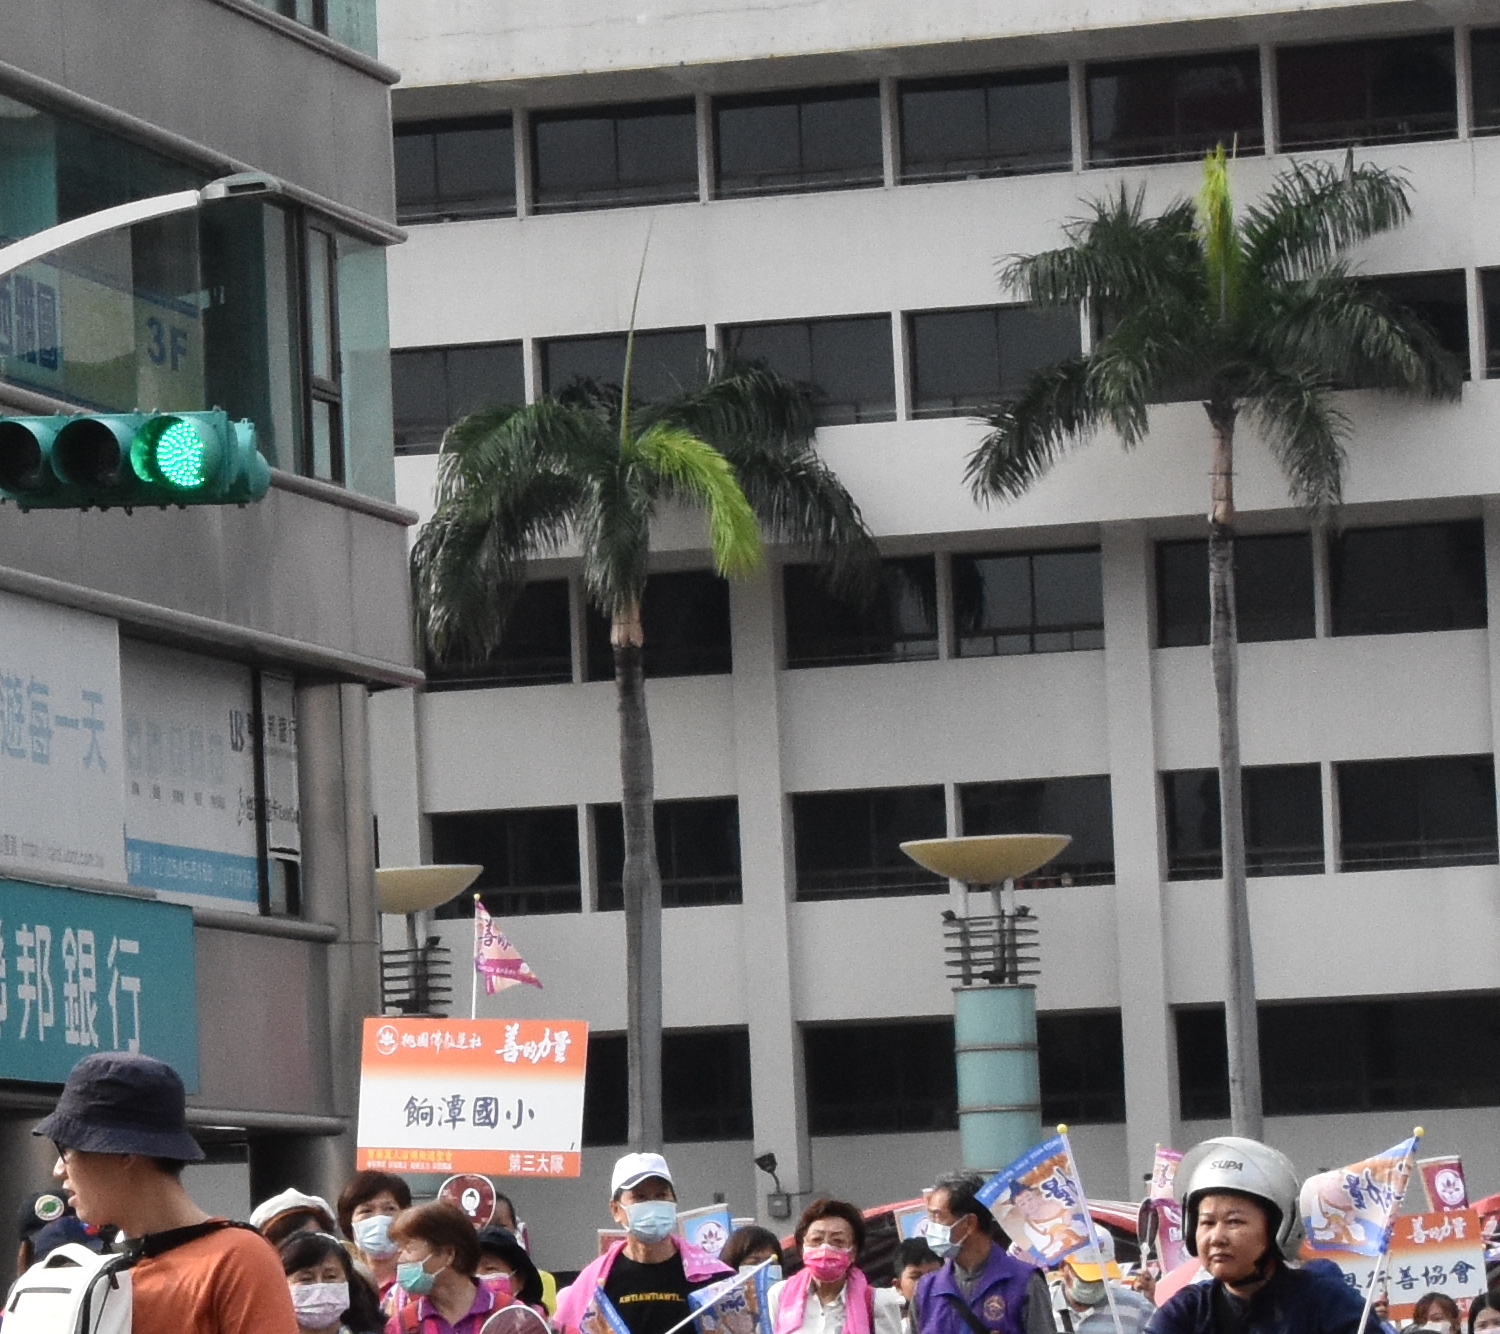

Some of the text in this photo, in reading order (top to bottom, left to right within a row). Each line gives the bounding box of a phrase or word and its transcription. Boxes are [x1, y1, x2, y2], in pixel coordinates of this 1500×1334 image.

[494, 1022, 572, 1064] 善的力量
[507, 1152, 565, 1174] 第三大隊
[1210, 1158, 1244, 1172] SUPA
